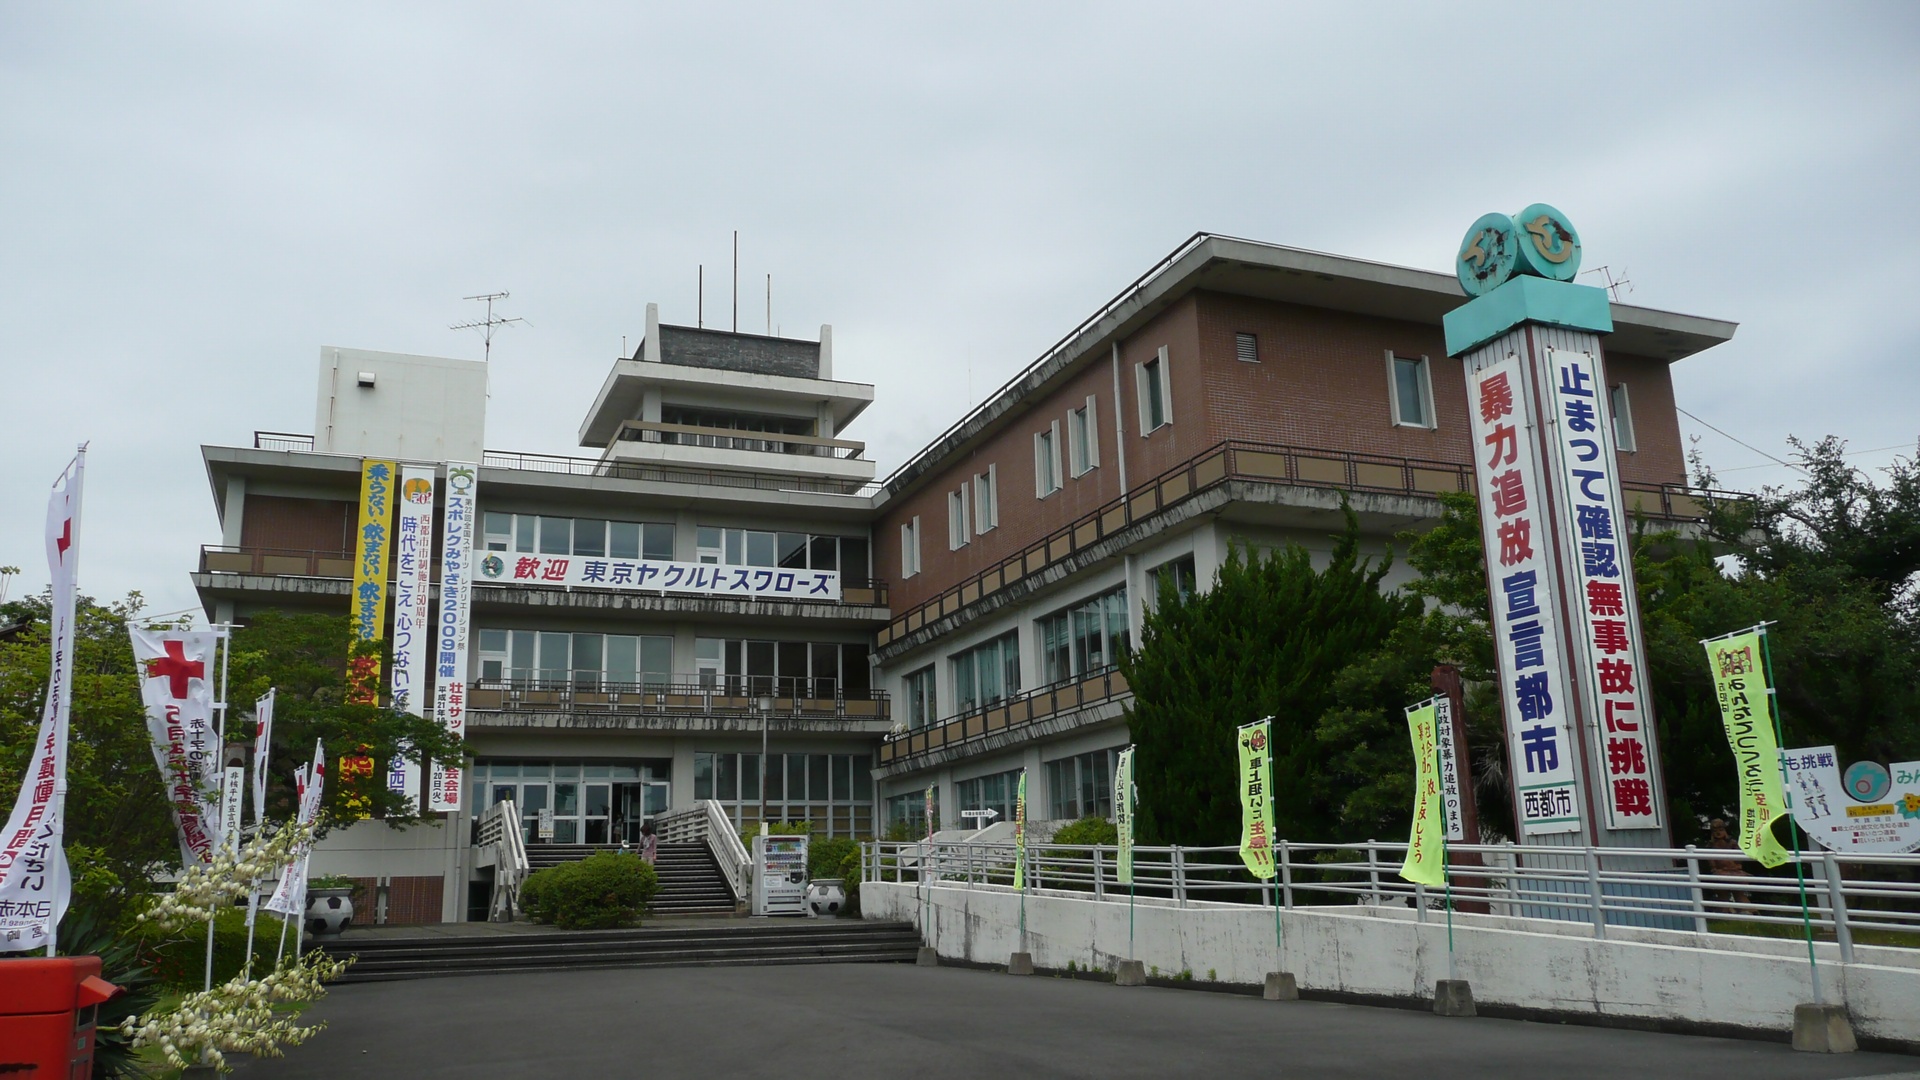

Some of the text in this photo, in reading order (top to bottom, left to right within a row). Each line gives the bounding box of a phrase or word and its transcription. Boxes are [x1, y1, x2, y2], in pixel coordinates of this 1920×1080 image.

[438, 496, 464, 679] スポレクみやざき2009開催
[513, 556, 836, 596] 歓迎 東京ヤクルトスワローズ
[1479, 371, 1559, 775] 暴力追放宣言都市
[1559, 363, 1653, 818] 止まって確認無事故に挑戦
[1437, 702, 1461, 834] 行政対象暴力追放のまち
[1524, 787, 1573, 819] 西都市
[1778, 752, 1834, 772] も挑戦
